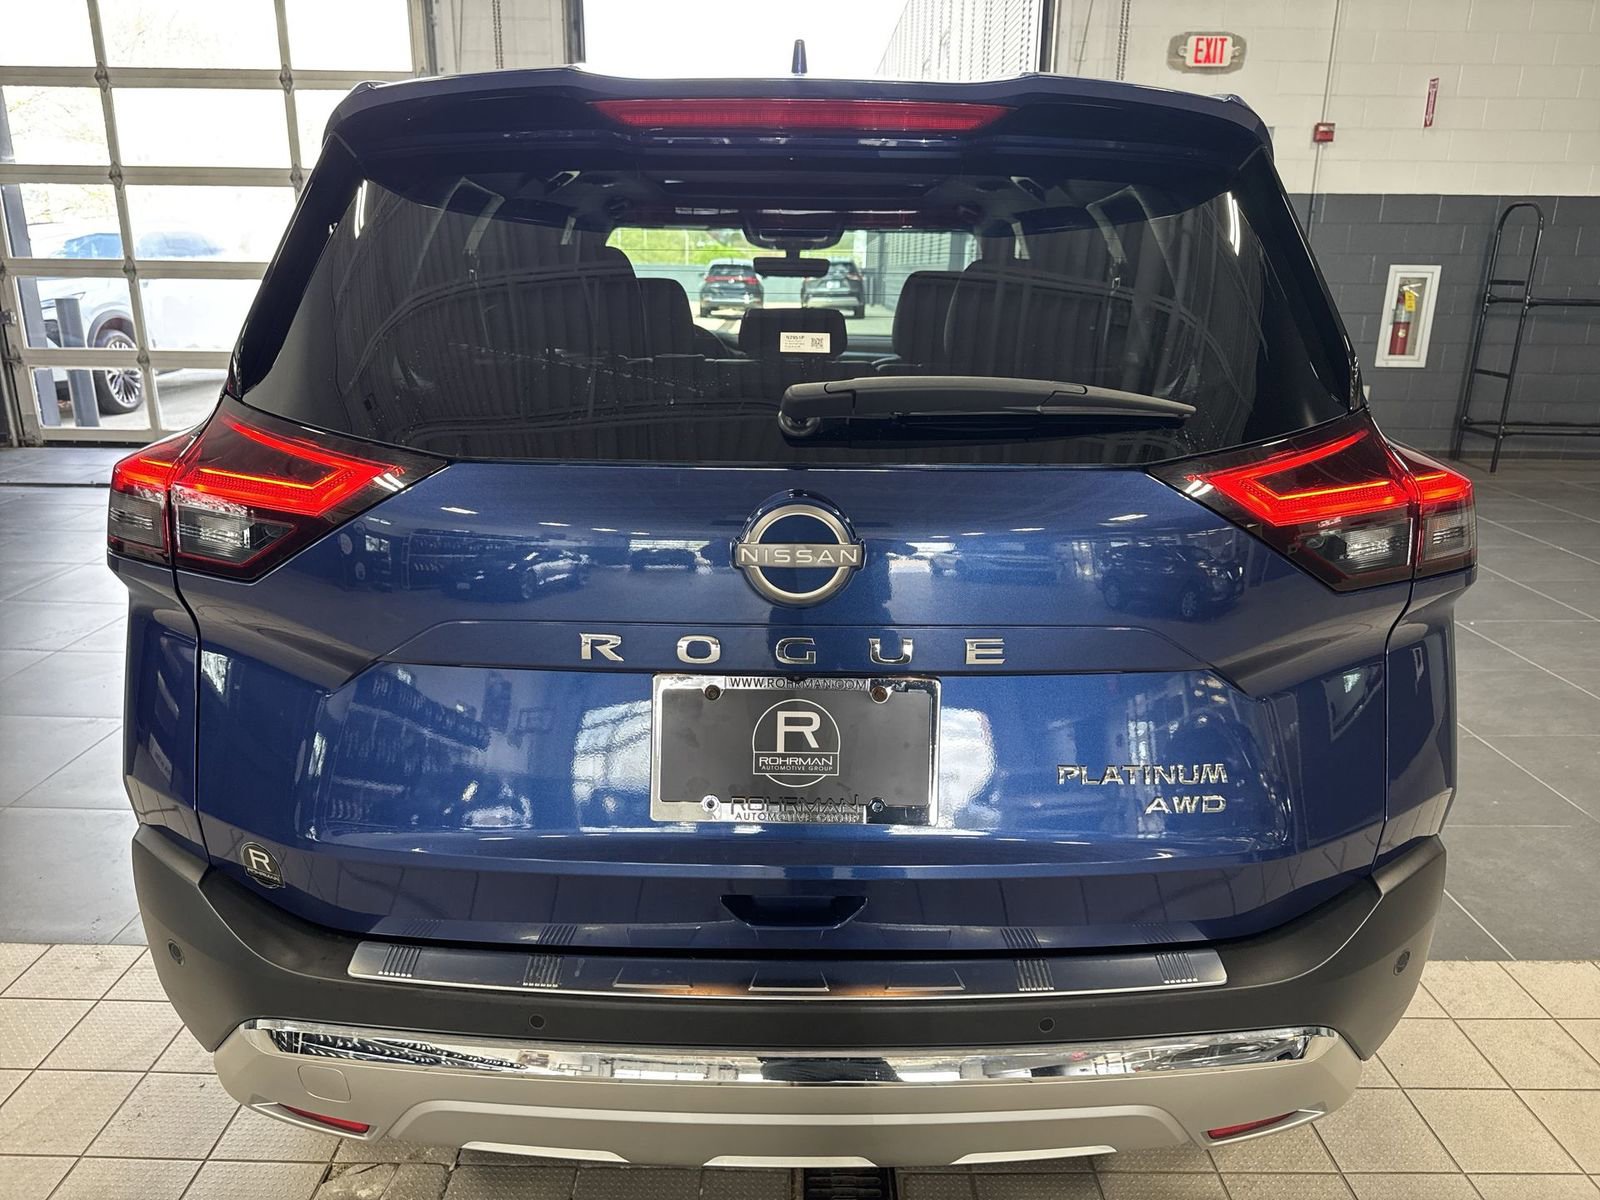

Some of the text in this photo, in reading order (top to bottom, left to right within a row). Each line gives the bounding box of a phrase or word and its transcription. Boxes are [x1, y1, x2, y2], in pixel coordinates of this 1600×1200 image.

[1194, 37, 1227, 64] EXIT
[741, 548, 857, 563] NISSAN
[579, 633, 1006, 665] ROGUE
[776, 711, 821, 753] R
[759, 756, 833, 767] ROHRMAN
[1057, 764, 1228, 785] PLATINUM
[731, 794, 859, 815] ROHRMAN
[1145, 795, 1227, 814] AWD
[734, 812, 812, 821] AUTOMOTIVE
[248, 848, 272, 872] R
